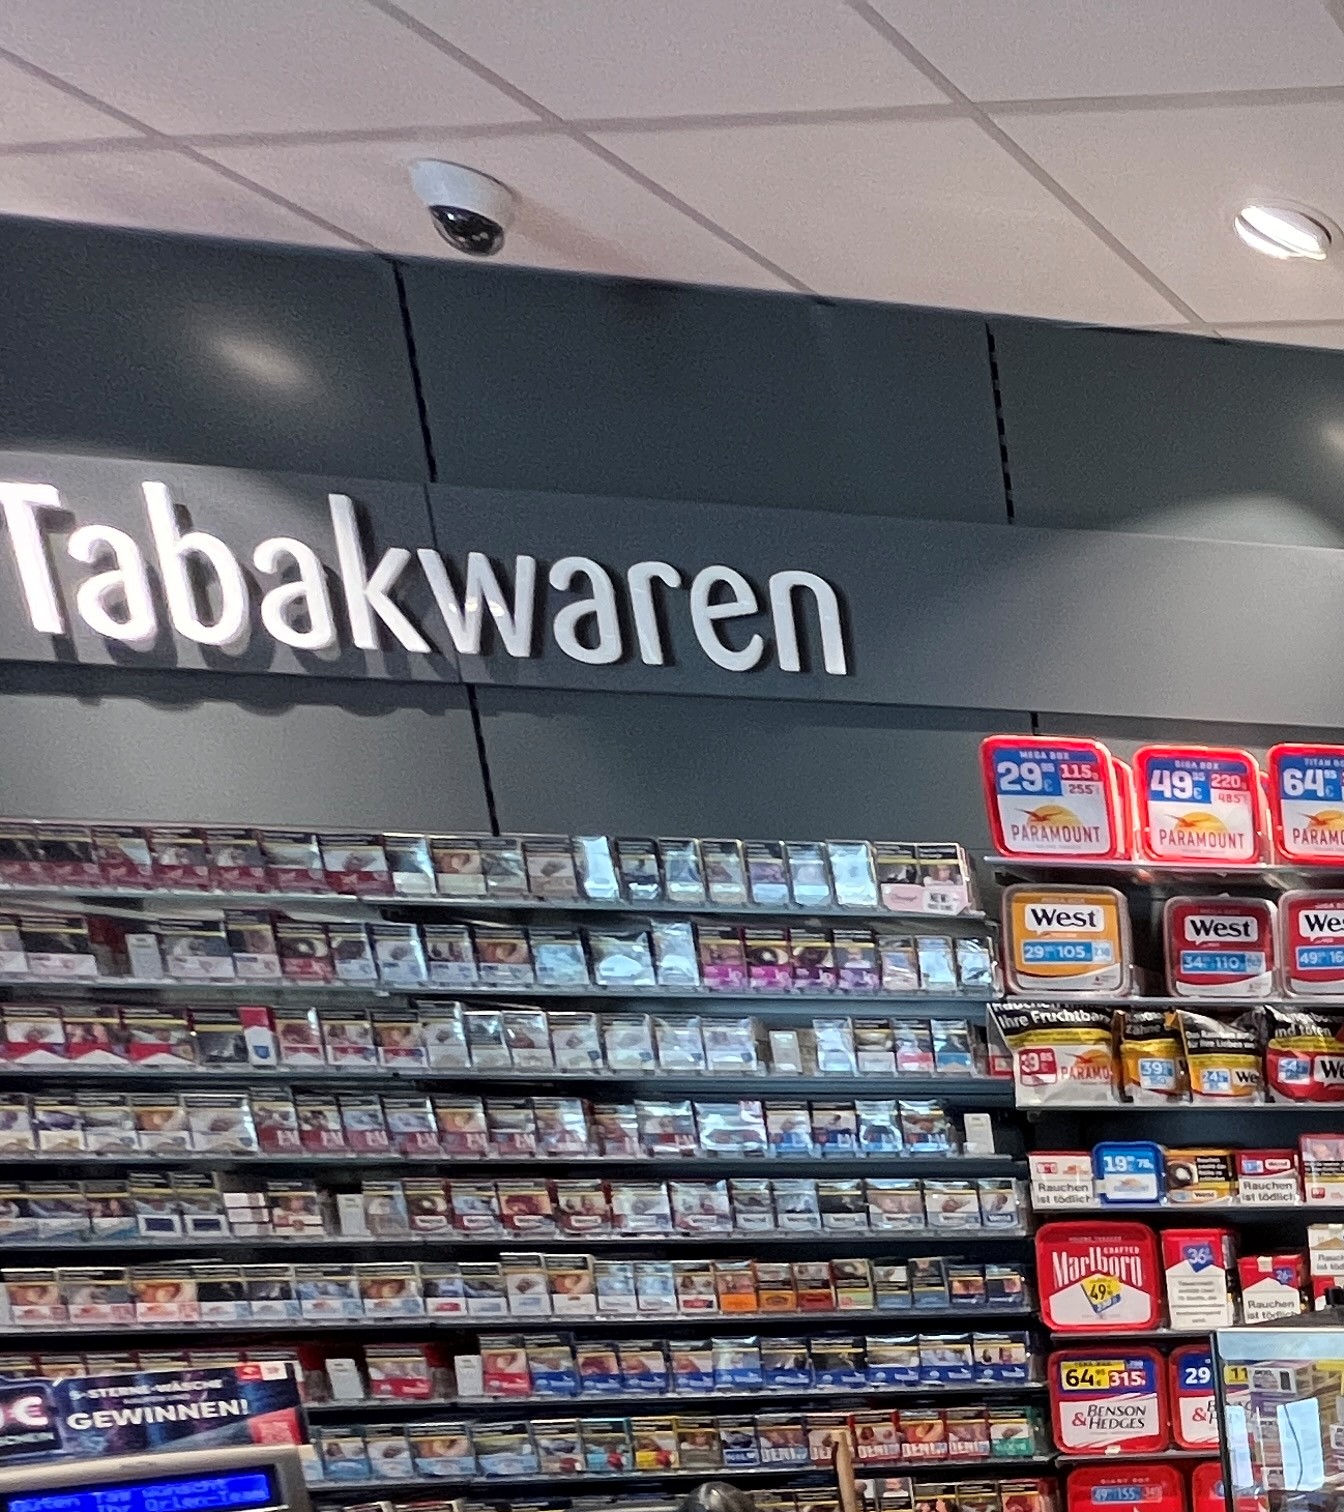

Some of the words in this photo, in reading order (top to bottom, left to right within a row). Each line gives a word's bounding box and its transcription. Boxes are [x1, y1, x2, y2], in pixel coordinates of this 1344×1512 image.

[0, 478, 847, 677] Tabakwaren
[1011, 824, 1101, 843] PARAMOUNT
[1159, 829, 1245, 849] PARAMOUNT
[1030, 907, 1097, 929] West
[1190, 918, 1251, 938] West
[1038, 1183, 1089, 1193] Rauchen
[1243, 1181, 1293, 1191] Rauchen
[1037, 1194, 1052, 1203] ist
[1242, 1191, 1255, 1201] ist
[1247, 1300, 1295, 1309] Rauchen
[67, 1399, 250, 1430] GEWINNEN!
[1072, 1411, 1087, 1427] &
[1089, 1417, 1145, 1430] HEDGES
[1087, 1404, 1147, 1418] BENSON
